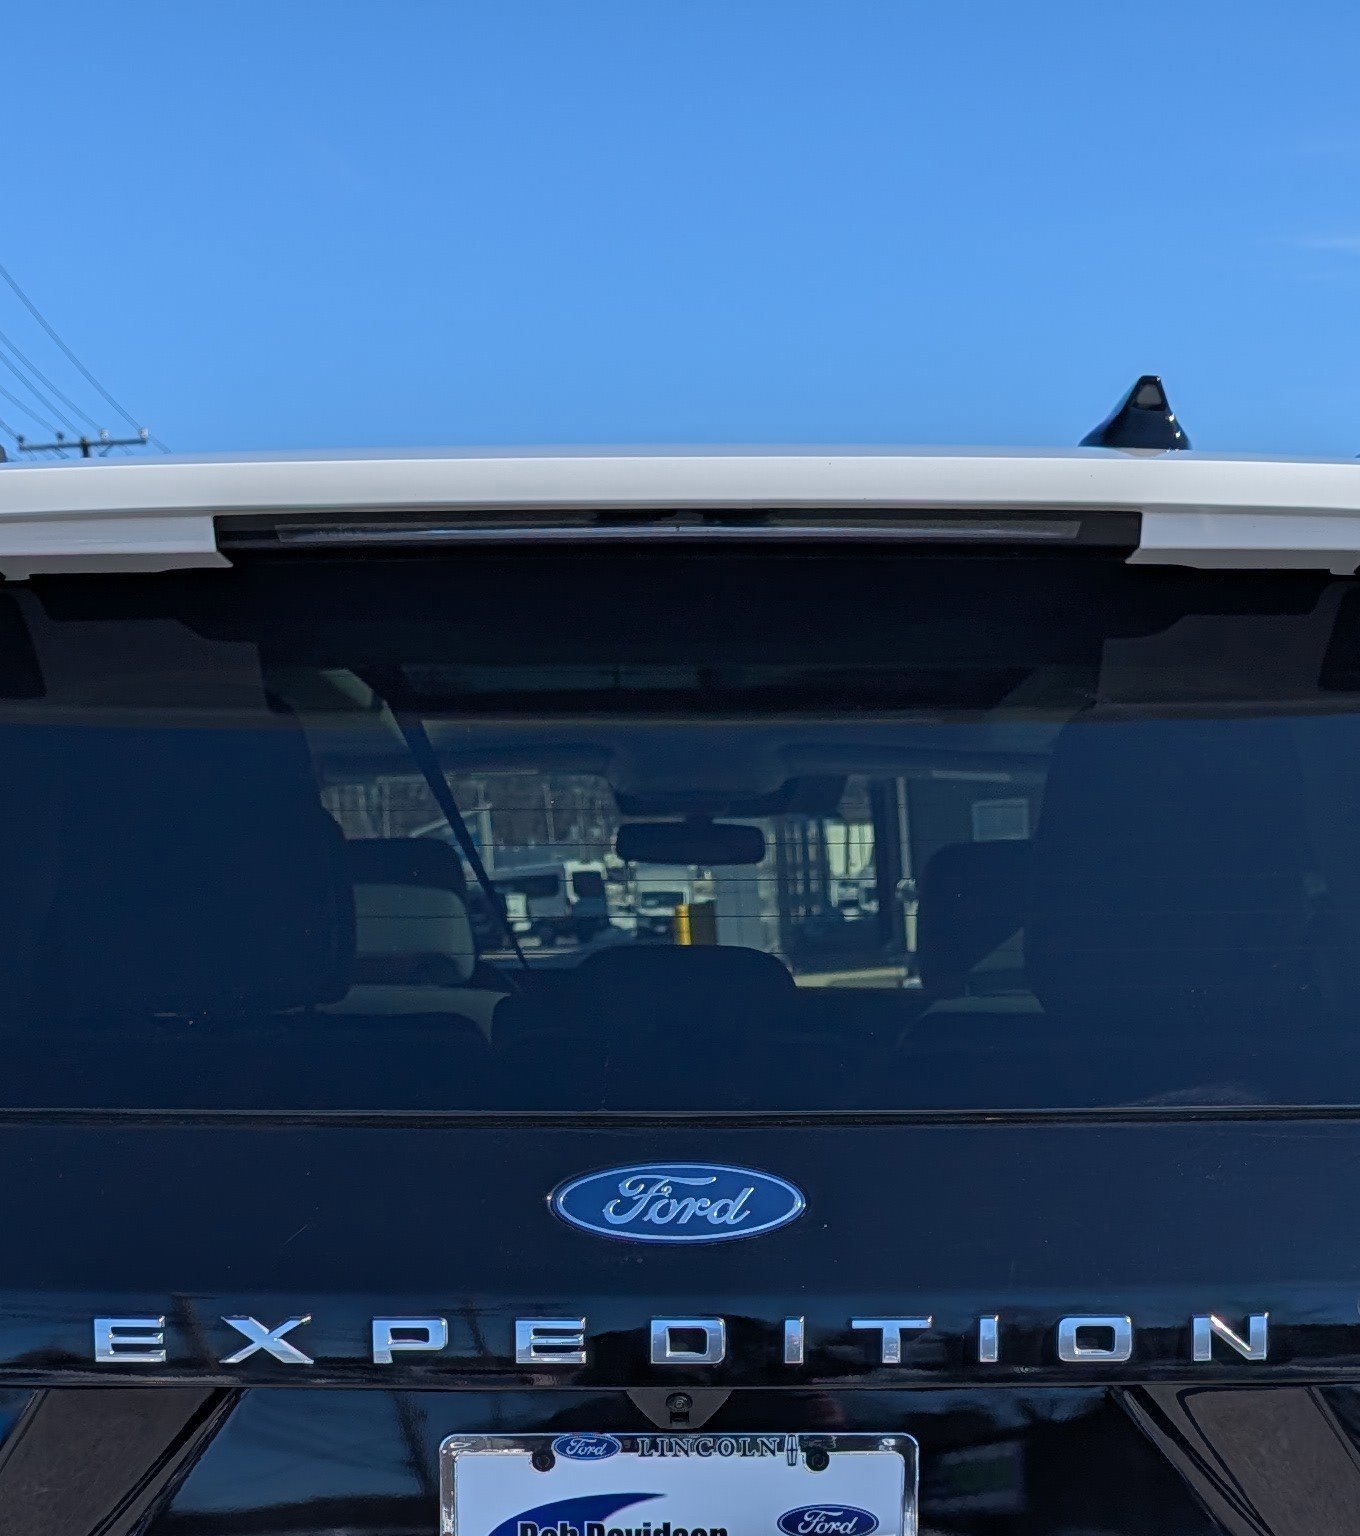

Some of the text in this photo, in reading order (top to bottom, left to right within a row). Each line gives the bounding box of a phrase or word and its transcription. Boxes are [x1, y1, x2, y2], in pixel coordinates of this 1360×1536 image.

[602, 1174, 755, 1225] Ford
[93, 1313, 1269, 1365] EXPEDITION
[636, 1436, 780, 1458] LINCOLN
[797, 1509, 859, 1535] Ford
